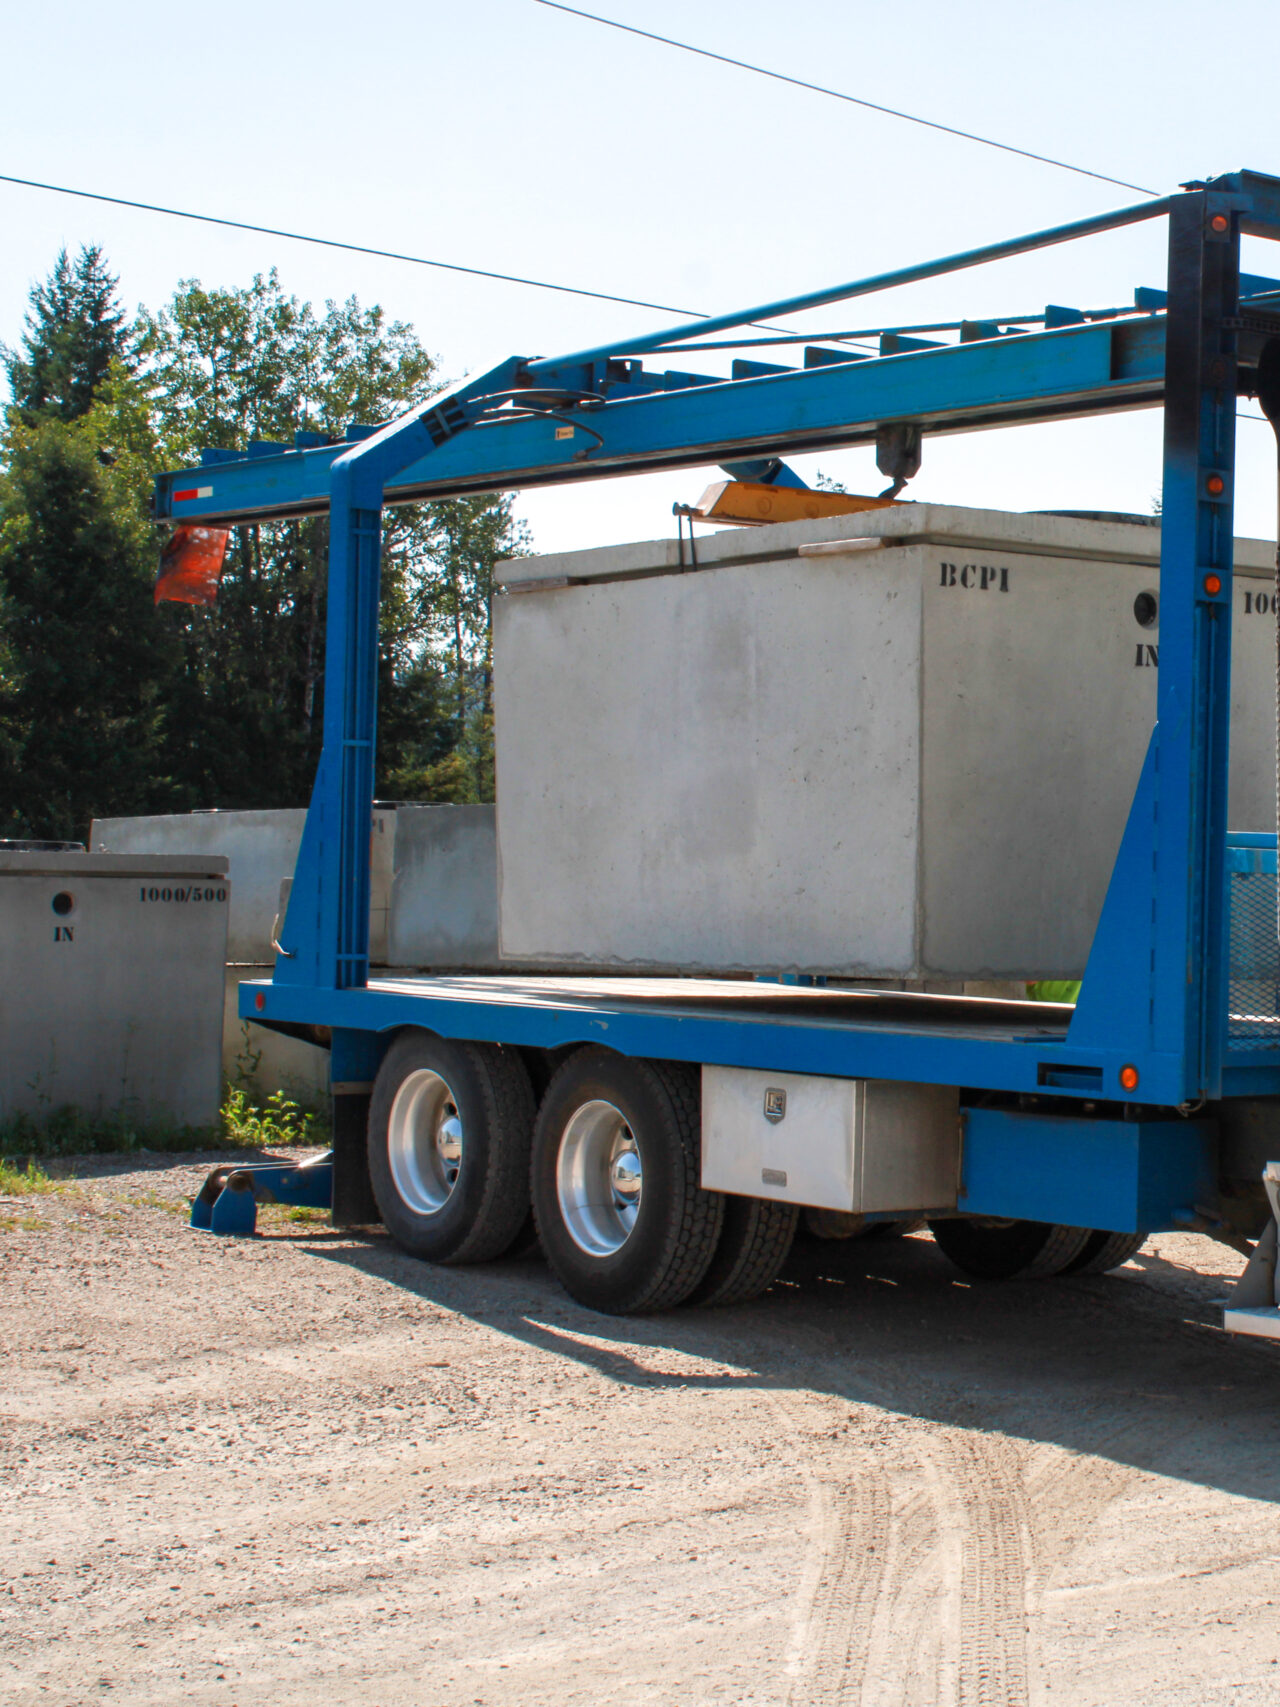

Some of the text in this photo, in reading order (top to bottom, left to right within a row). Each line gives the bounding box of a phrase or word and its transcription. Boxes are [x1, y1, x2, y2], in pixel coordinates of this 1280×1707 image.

[939, 562, 1008, 592] BCPI
[1135, 643, 1159, 668] IN
[140, 887, 227, 903] 1000/500
[53, 926, 74, 942] IN
